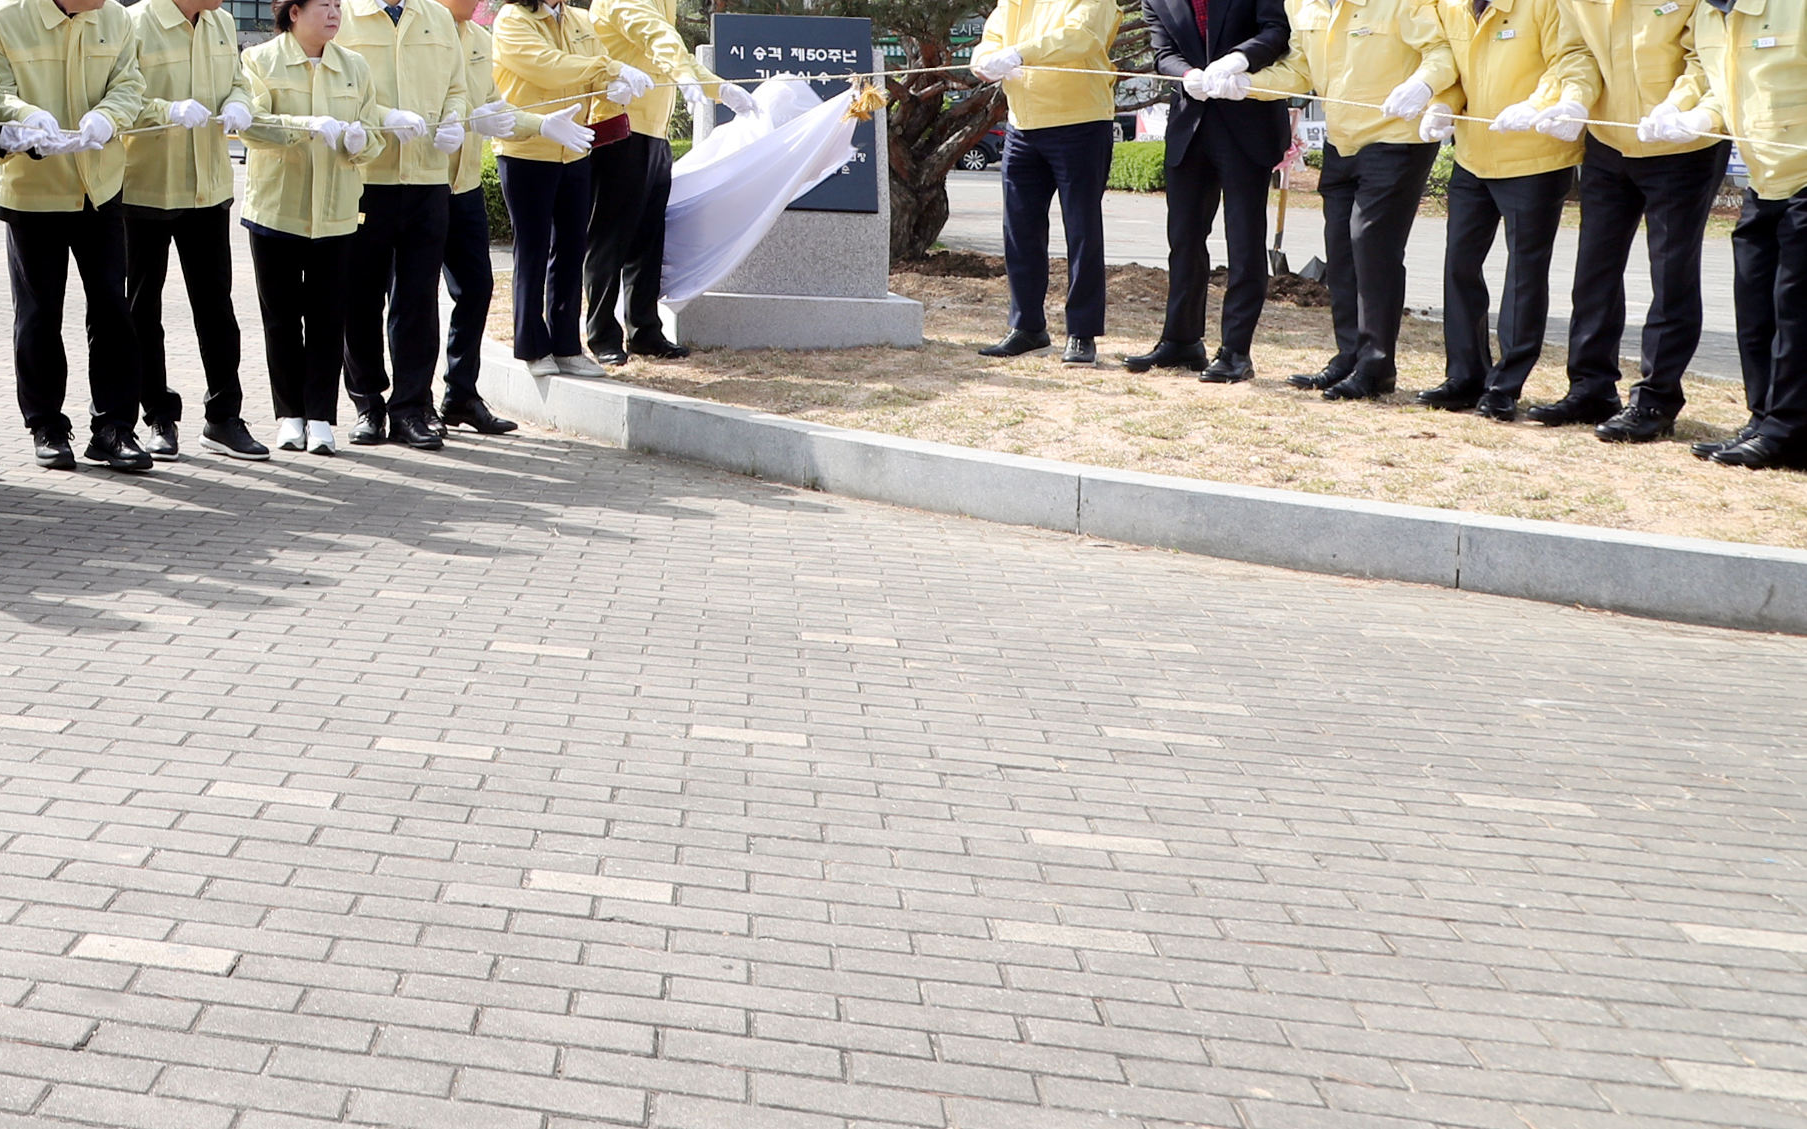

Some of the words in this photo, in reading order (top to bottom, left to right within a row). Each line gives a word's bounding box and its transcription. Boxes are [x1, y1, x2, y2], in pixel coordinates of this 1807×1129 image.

[729, 45, 745, 60] 시
[752, 46, 783, 61] 승격
[790, 47, 858, 64] 제50주년
